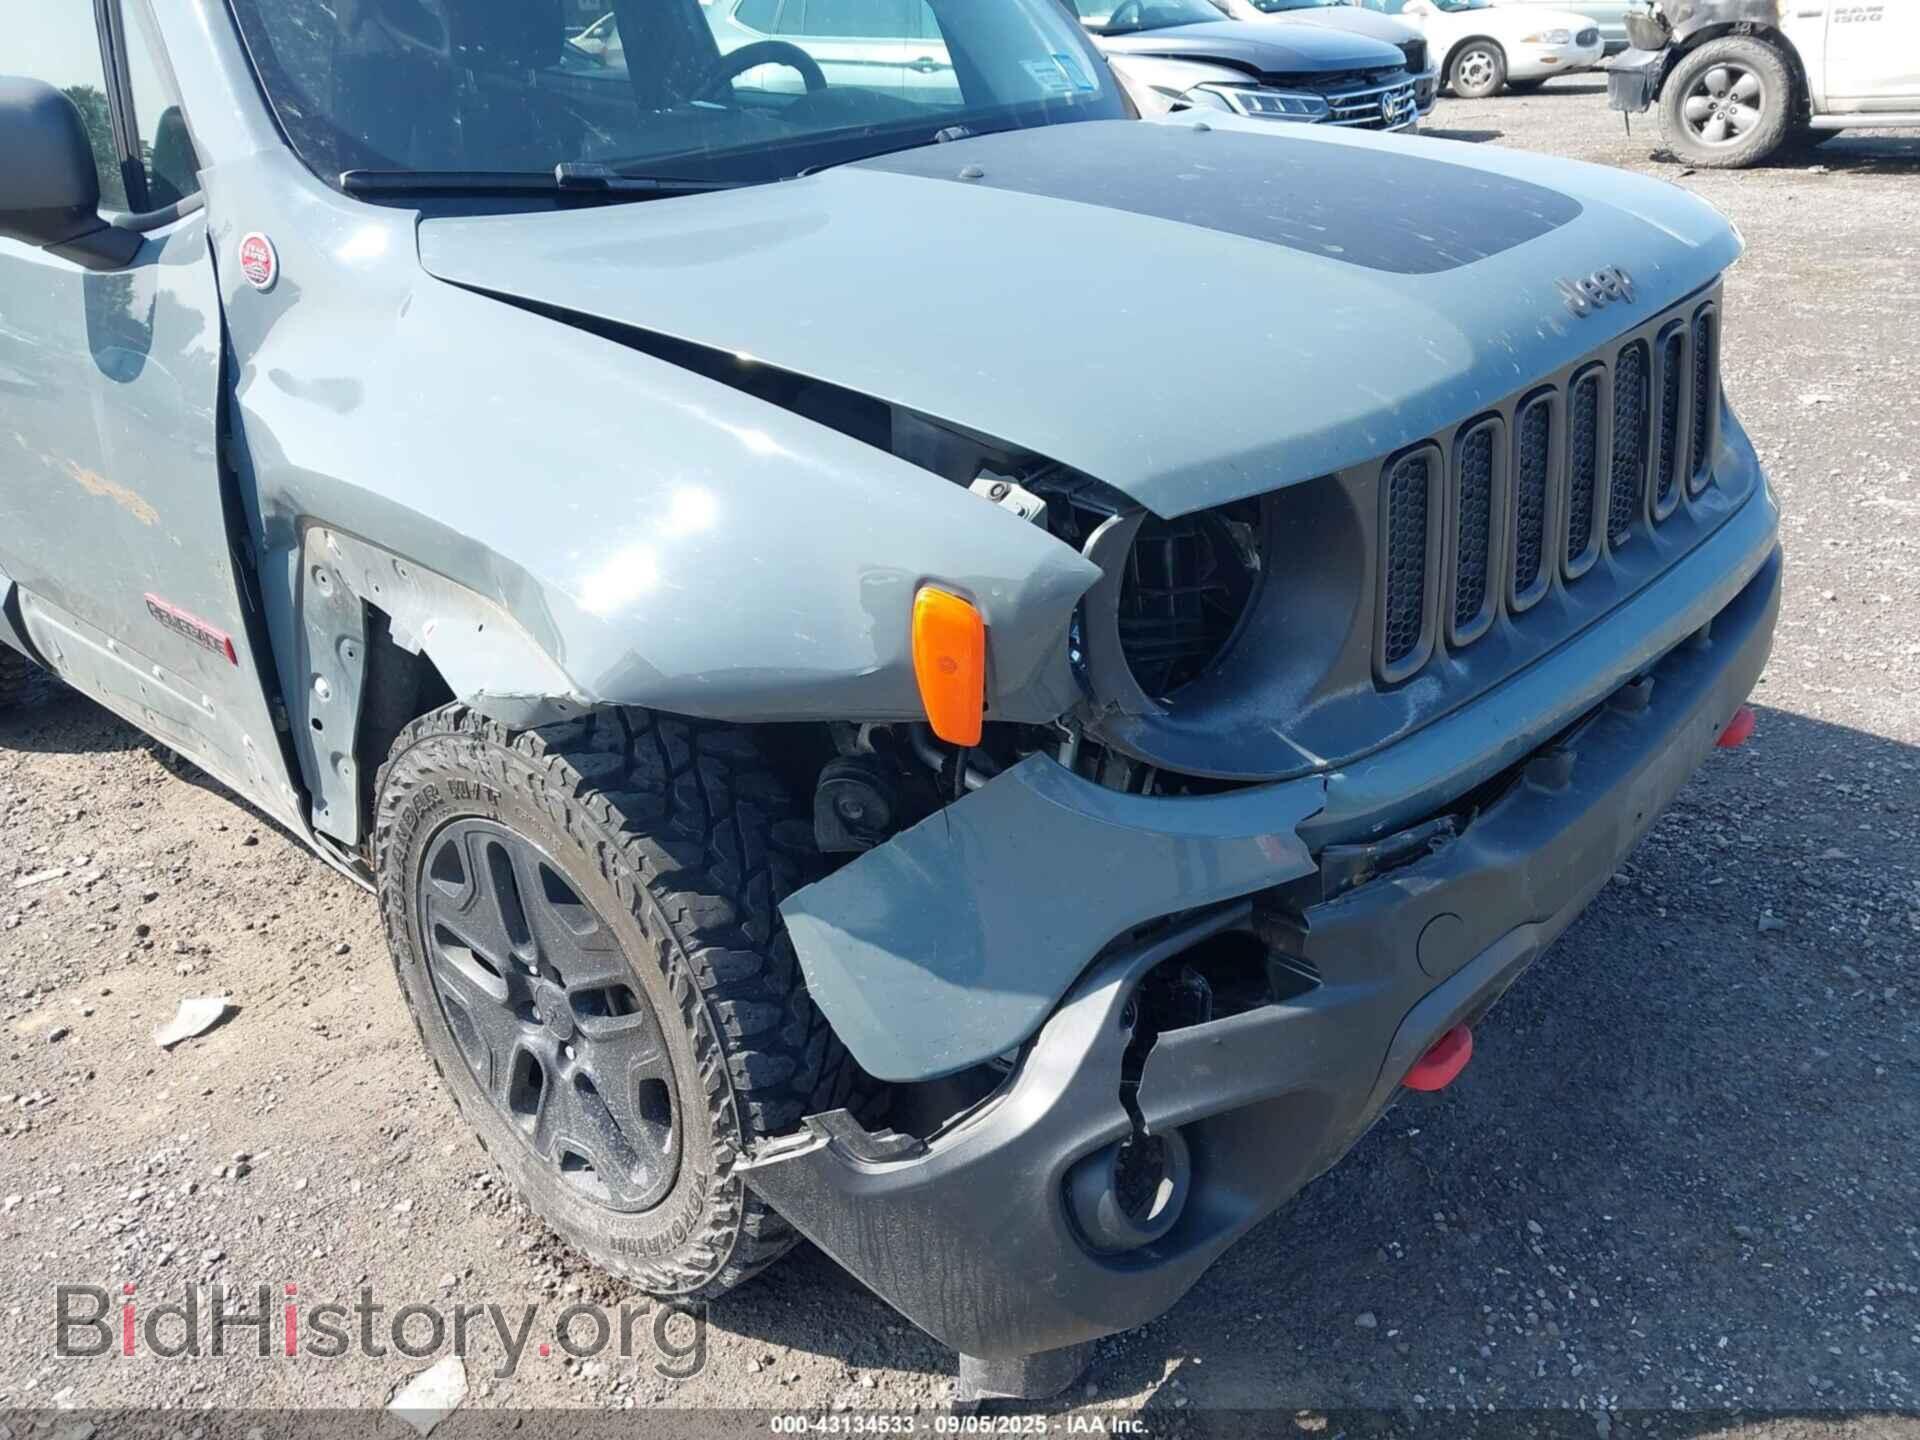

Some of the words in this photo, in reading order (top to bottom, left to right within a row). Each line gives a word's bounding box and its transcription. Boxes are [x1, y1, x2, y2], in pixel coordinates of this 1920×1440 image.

[1834, 6, 1884, 15] RAM
[1834, 14, 1882, 23] 1500
[1553, 264, 1632, 317] Jeep
